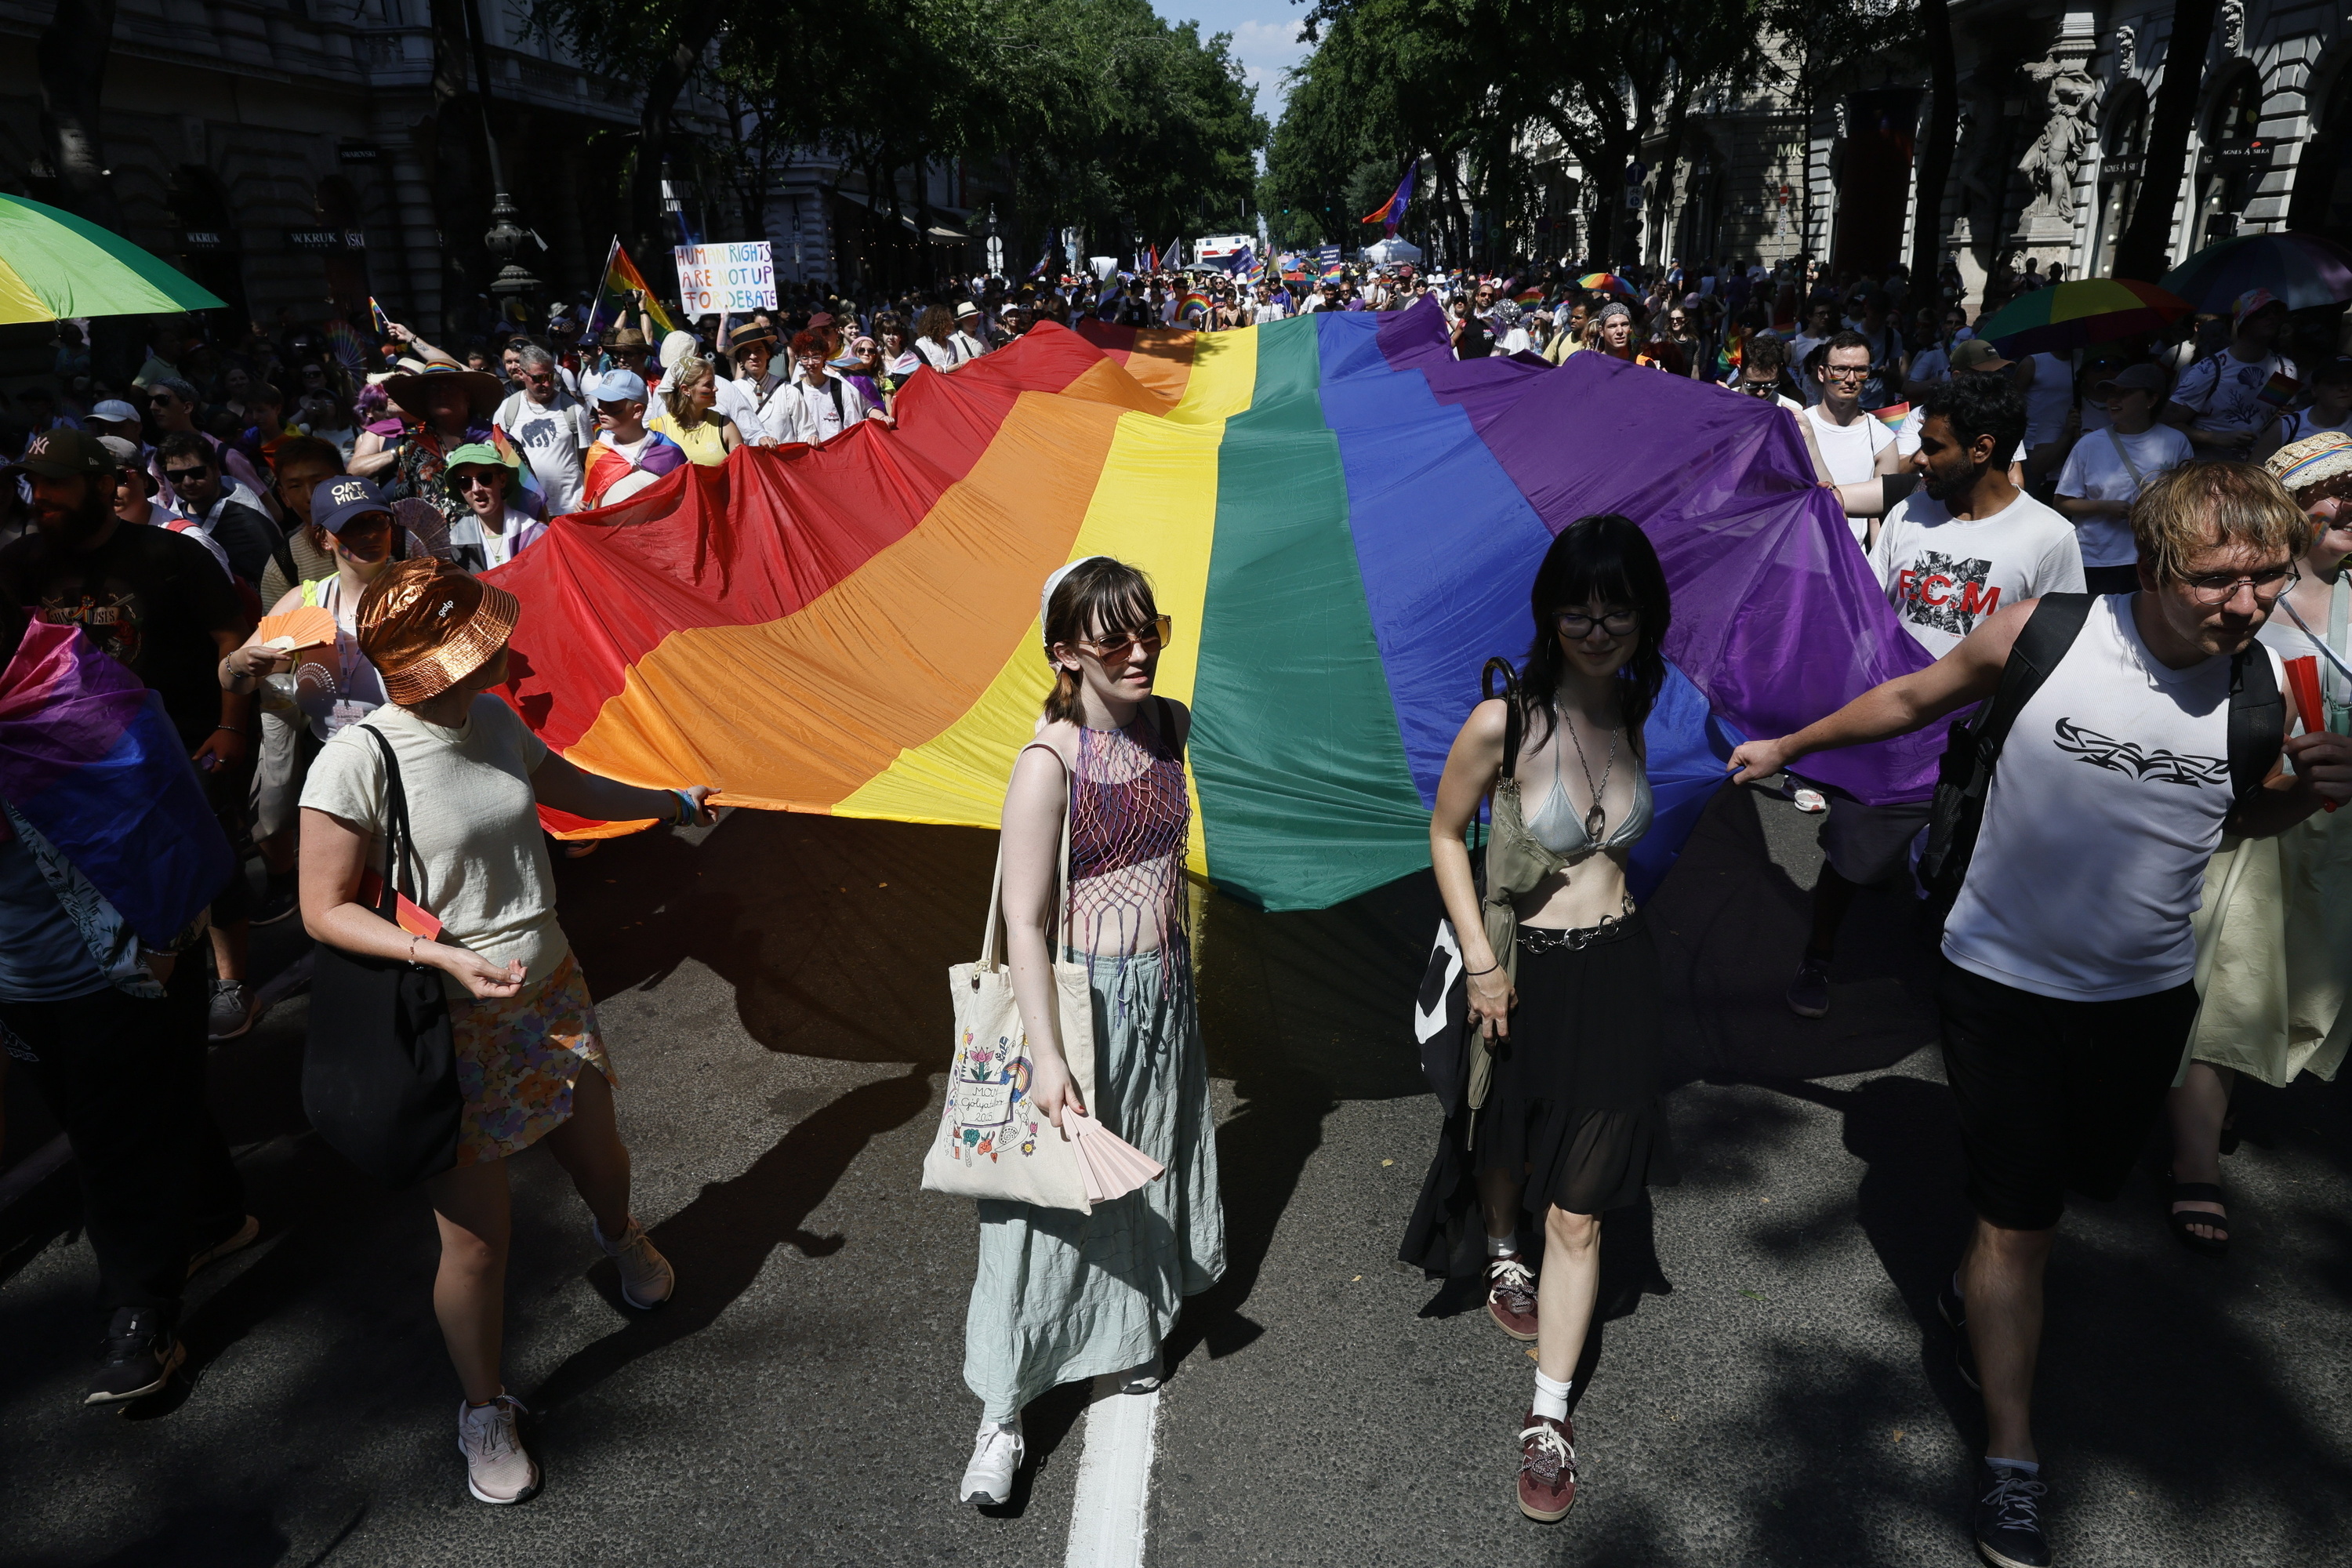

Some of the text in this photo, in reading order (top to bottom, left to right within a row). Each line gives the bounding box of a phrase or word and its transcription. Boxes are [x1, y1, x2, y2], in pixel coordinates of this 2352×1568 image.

[1777, 142, 1806, 158] MIC
[2103, 164, 2119, 173] AGNES
[665, 199, 683, 212] LIVE
[345, 234, 365, 247] VSKI
[676, 244, 772, 267] HUMAN RIGHTS
[682, 266, 772, 289] ARE NOT UP
[684, 290, 776, 311] FOR DEBATE
[331, 481, 362, 495] OAT
[334, 491, 369, 506] MILK
[437, 600, 454, 618] galp
